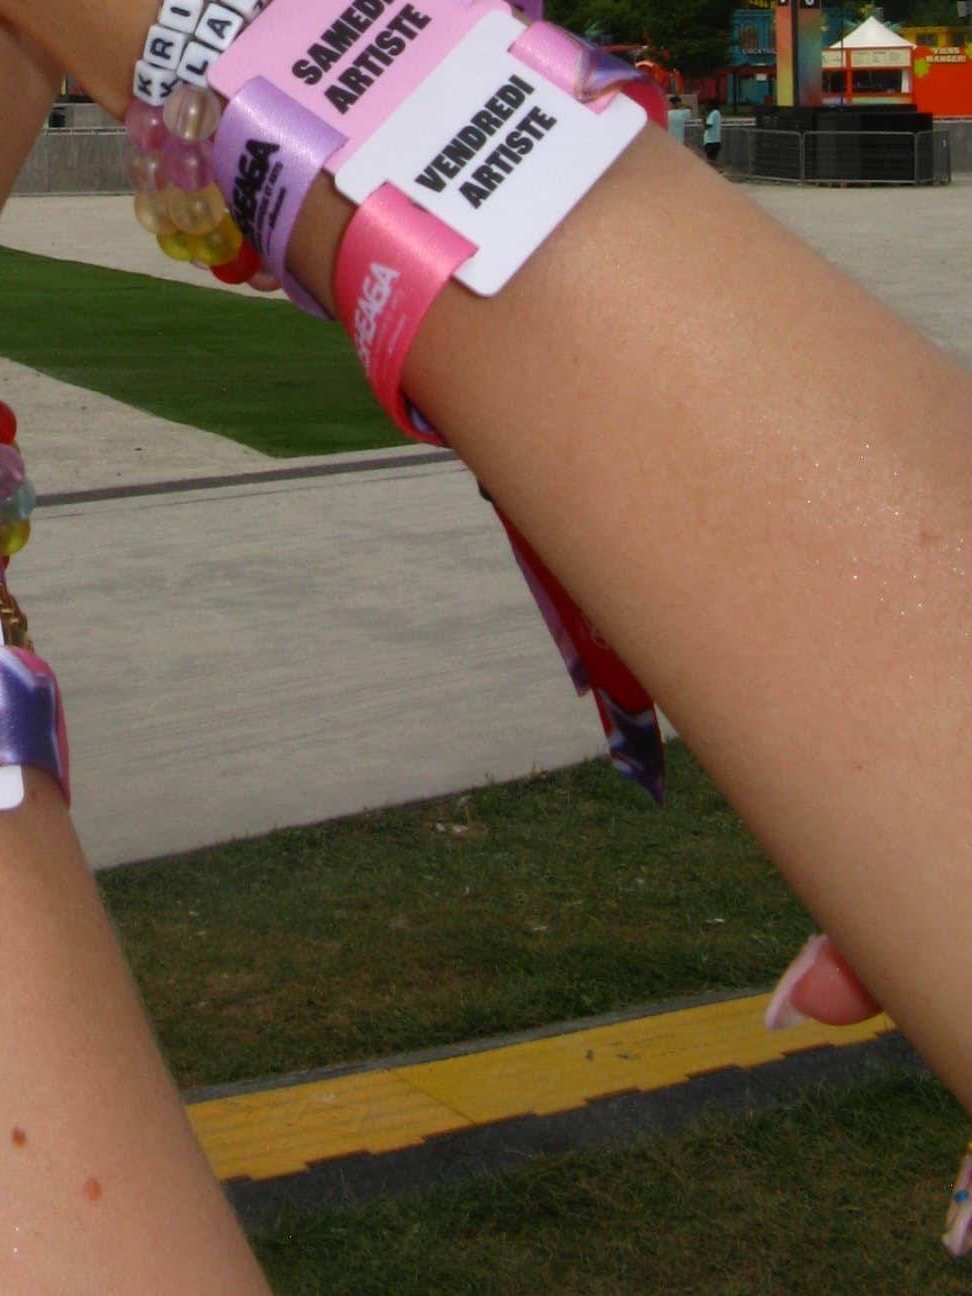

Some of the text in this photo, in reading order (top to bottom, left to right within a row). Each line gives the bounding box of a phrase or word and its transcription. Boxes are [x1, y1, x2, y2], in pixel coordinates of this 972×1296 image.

[323, 3, 432, 115] ARTISTE
[414, 75, 536, 194] VENDREDI
[457, 106, 557, 210] ARTISTE
